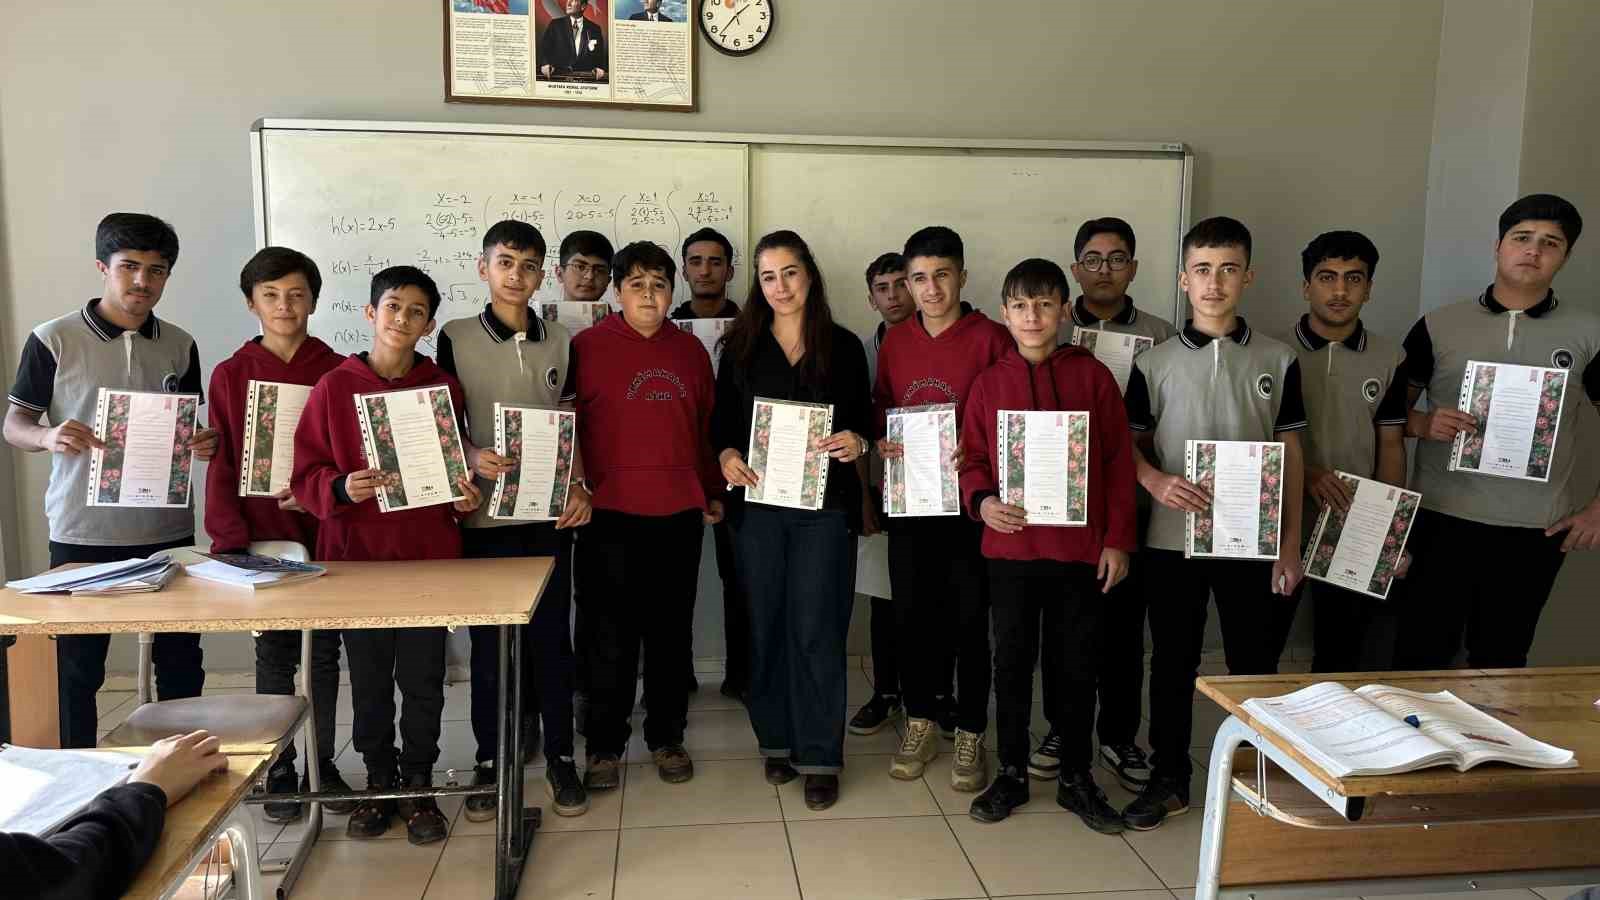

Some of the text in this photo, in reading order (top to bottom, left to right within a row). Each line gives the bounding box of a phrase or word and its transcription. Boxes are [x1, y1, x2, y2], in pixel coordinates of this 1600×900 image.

[706, 11, 714, 20] 9
[760, 11, 766, 20] 3
[711, 25, 718, 33] 8
[756, 25, 762, 33] 4
[720, 34, 727, 43] 7
[733, 38, 740, 47] 6
[748, 34, 754, 43] 5
